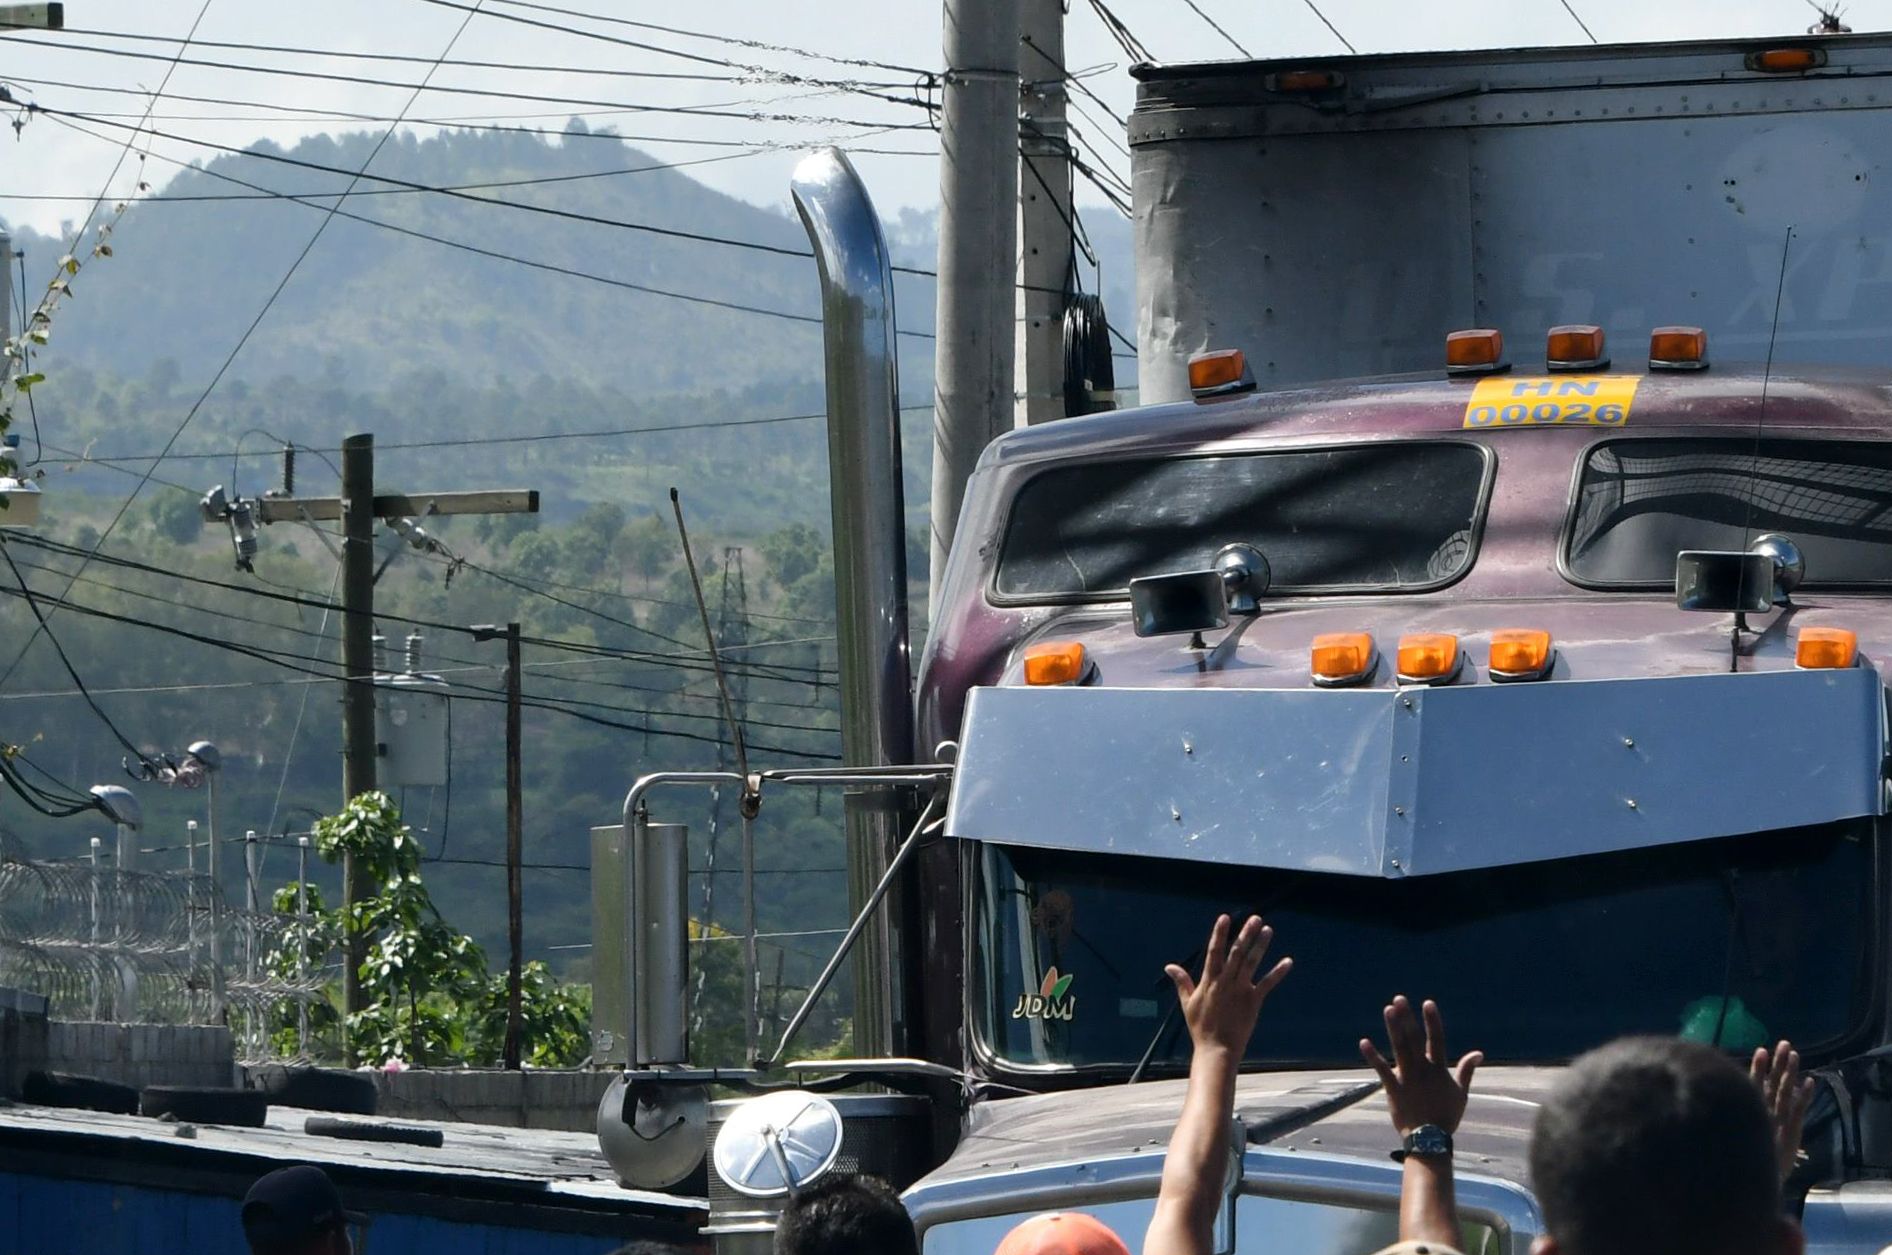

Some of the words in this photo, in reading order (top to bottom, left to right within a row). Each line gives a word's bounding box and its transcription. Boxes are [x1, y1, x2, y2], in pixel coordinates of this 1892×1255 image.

[1511, 381, 1600, 396] HN
[1469, 403, 1623, 425] 00026
[1012, 993, 1076, 1021] JDM
